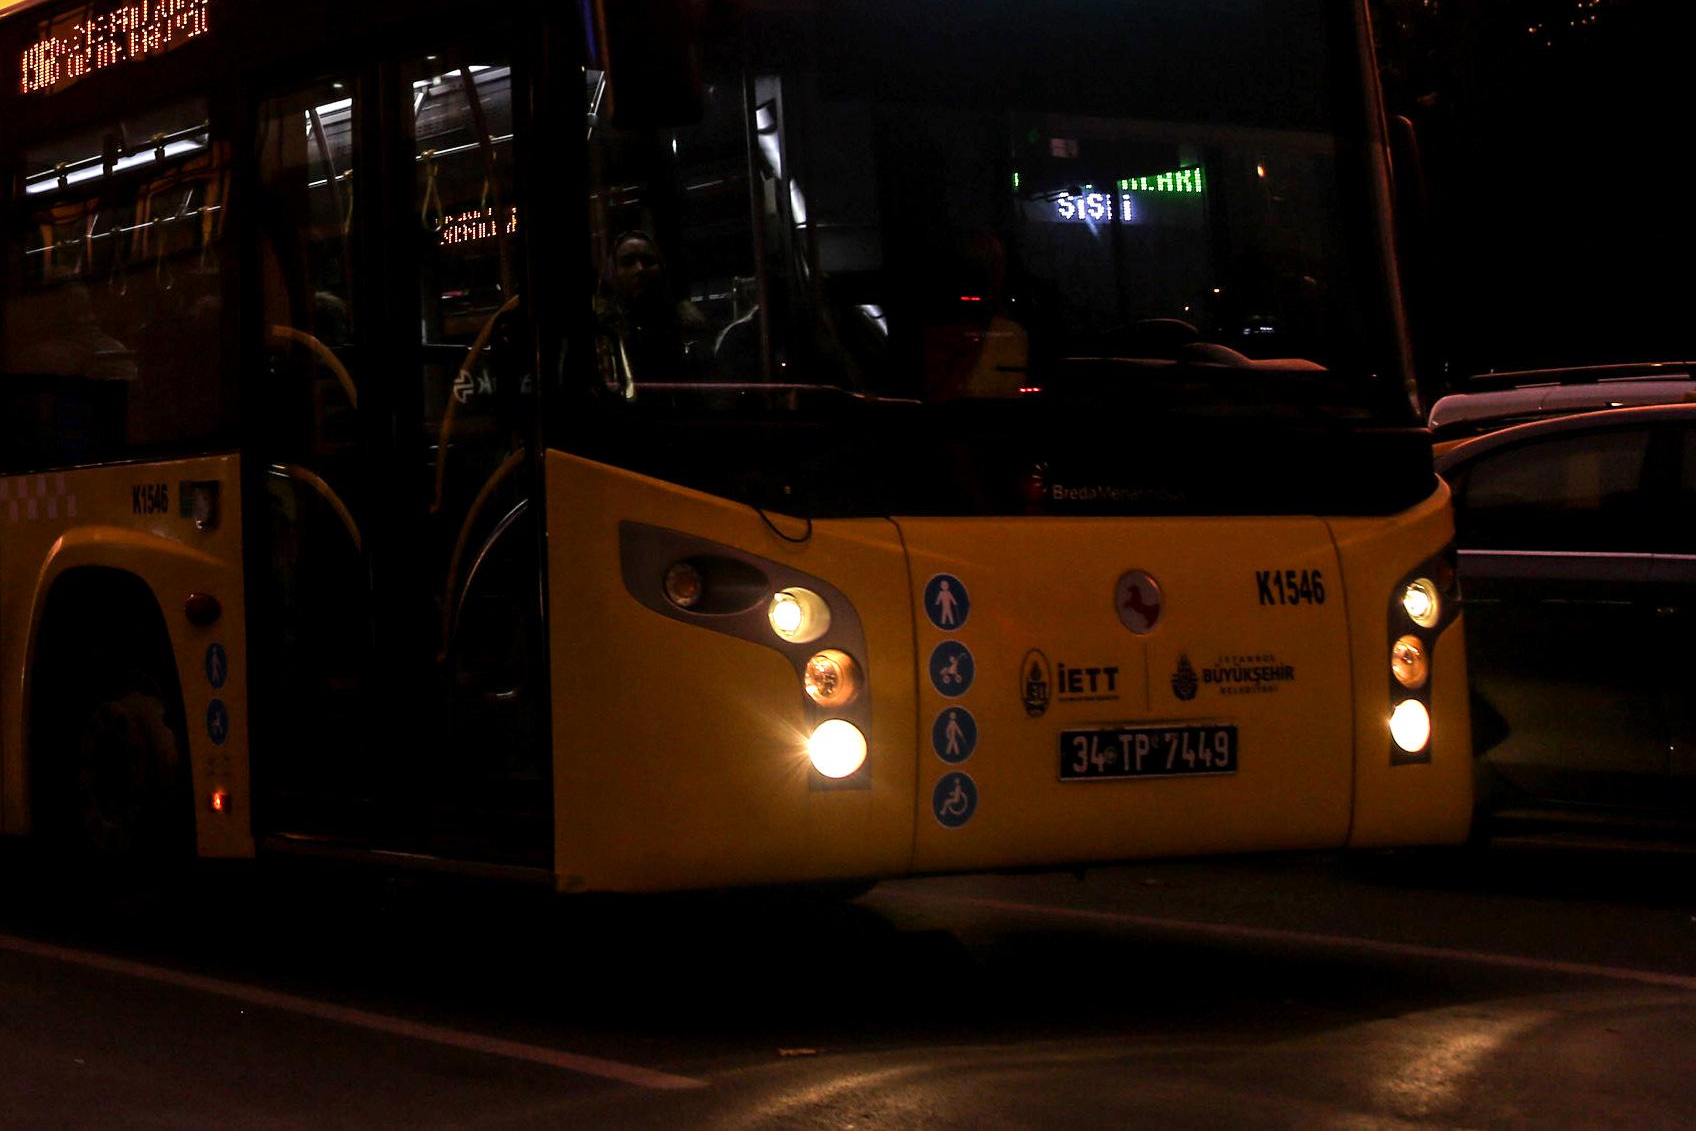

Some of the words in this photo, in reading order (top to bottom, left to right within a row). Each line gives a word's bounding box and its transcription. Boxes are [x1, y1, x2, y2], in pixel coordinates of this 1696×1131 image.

[132, 483, 169, 514] K1546
[1256, 570, 1325, 606] K1546
[1058, 662, 1119, 693] İETT
[1203, 660, 1295, 687] BÜYÜKŞEHİR
[1072, 734, 1105, 774] 34
[1119, 733, 1150, 772] TP
[1165, 730, 1230, 770] 7449
